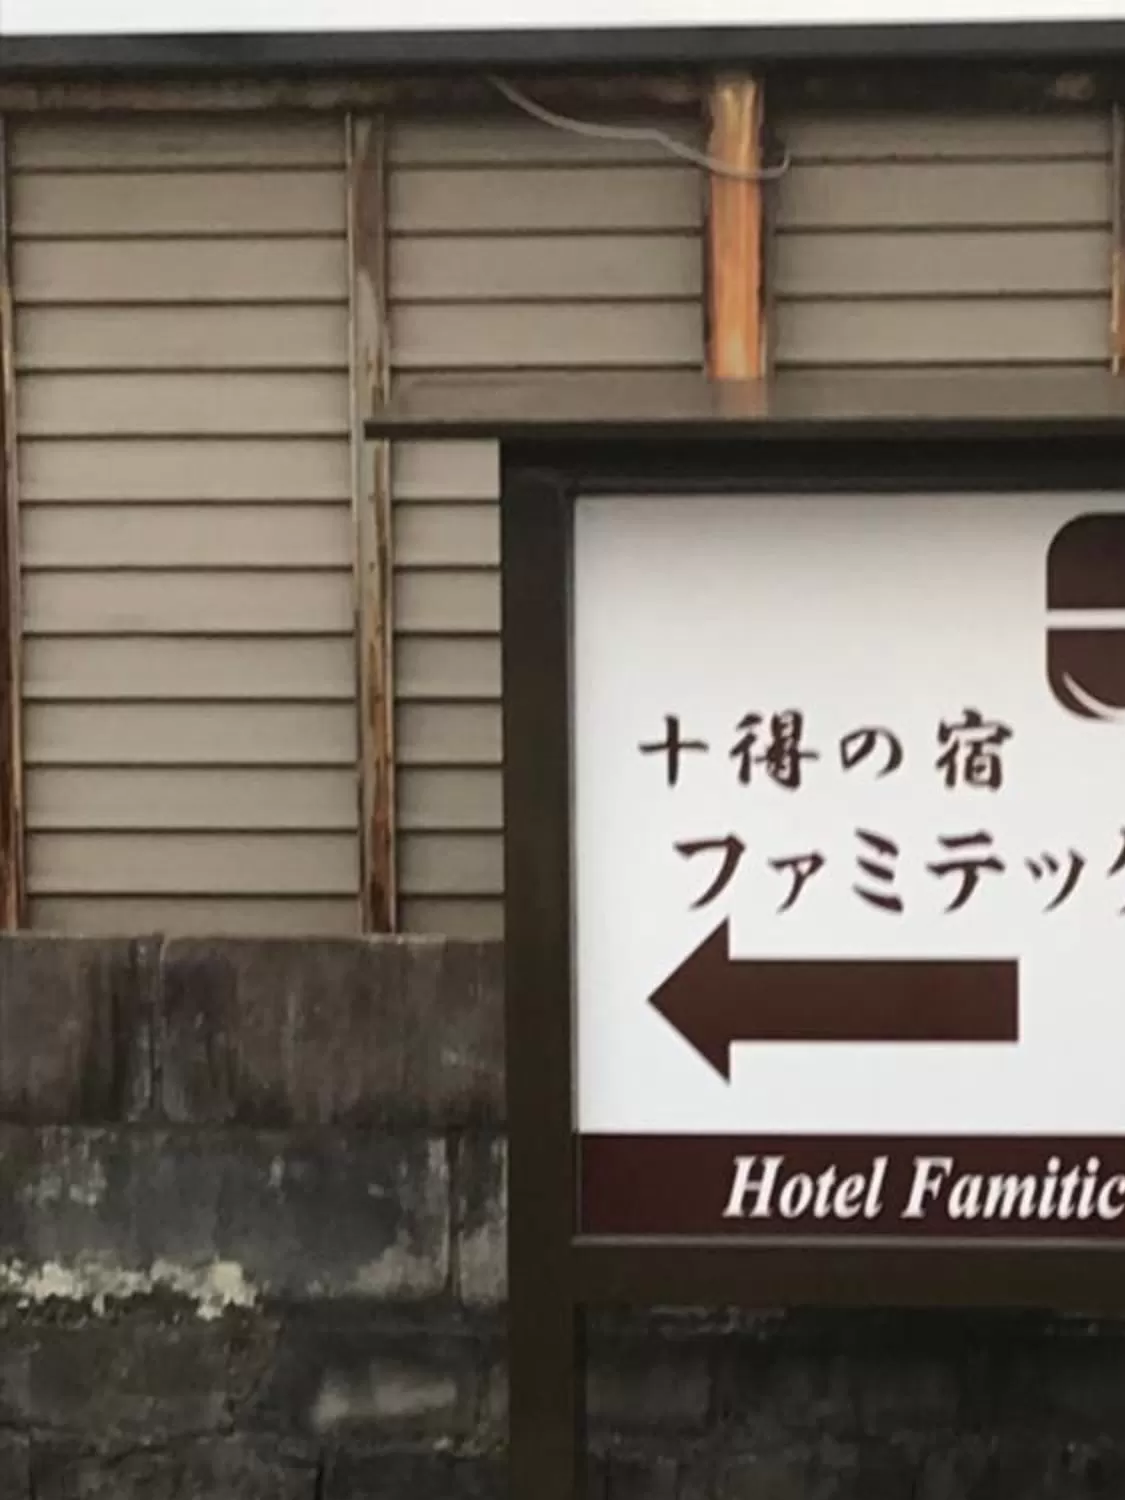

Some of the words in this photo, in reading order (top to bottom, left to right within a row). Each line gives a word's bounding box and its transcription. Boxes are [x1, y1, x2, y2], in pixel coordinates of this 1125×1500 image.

[637, 708, 1014, 792] 十得の宿
[722, 1155, 889, 1219] Hotel
